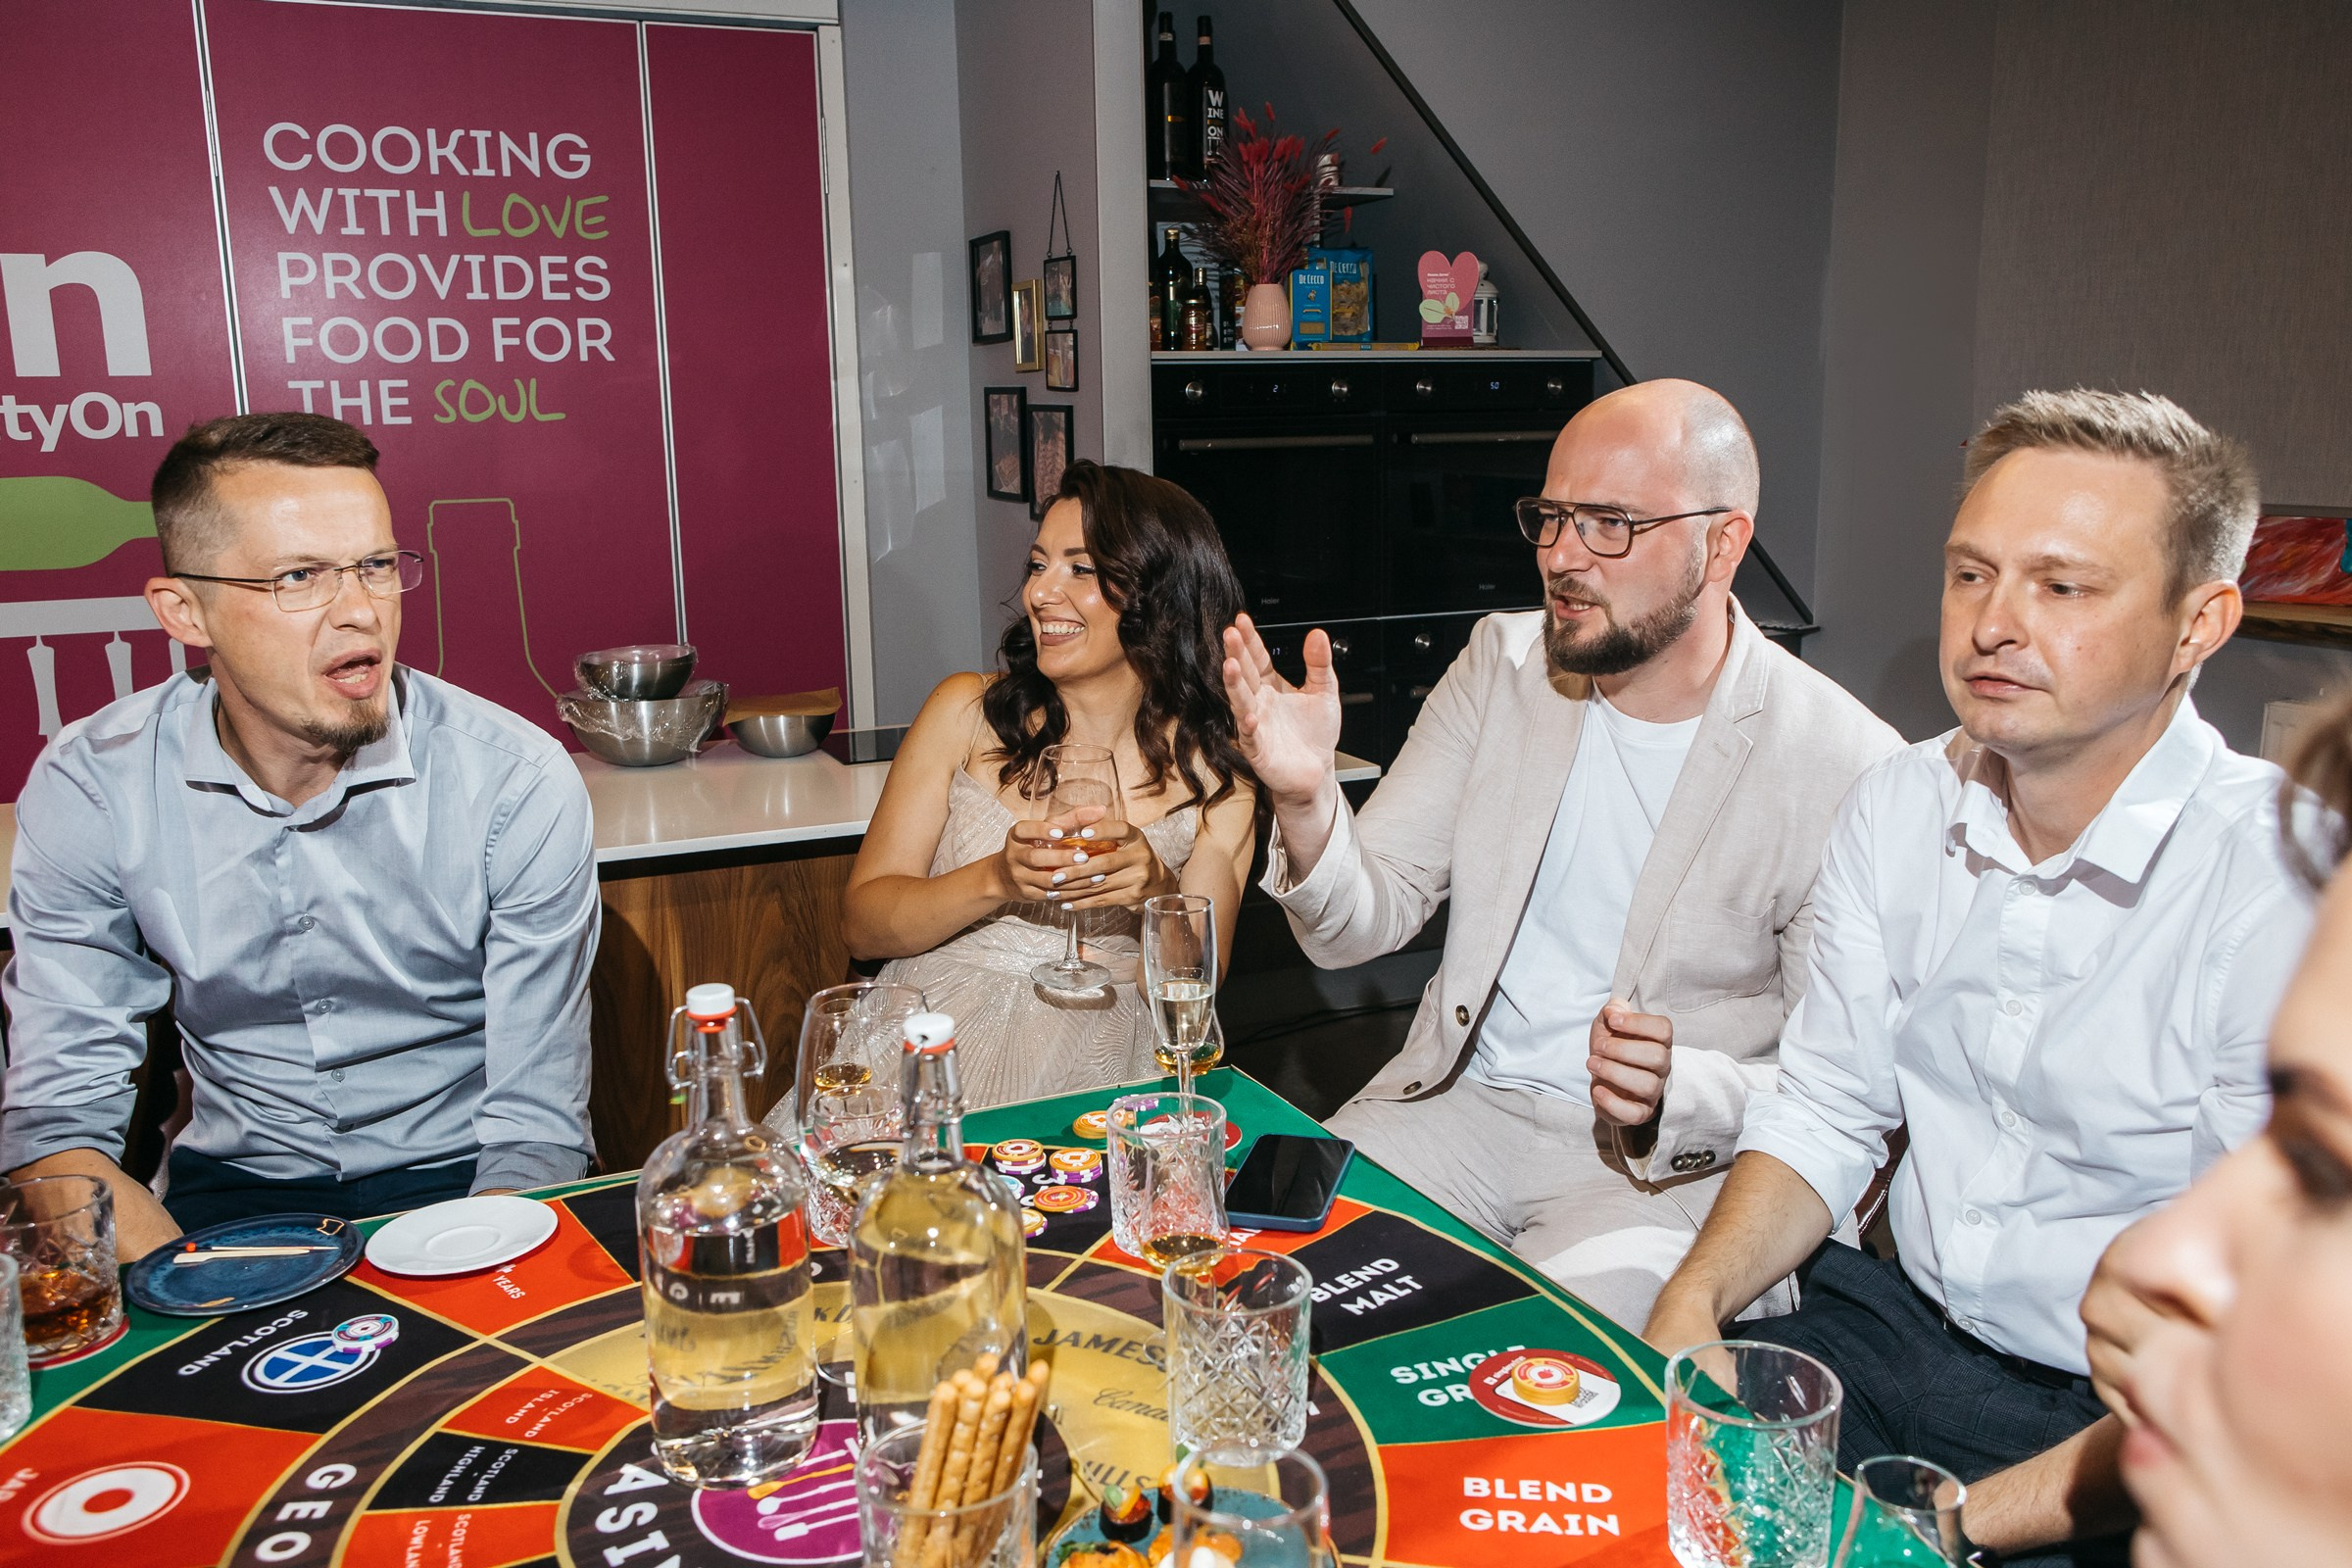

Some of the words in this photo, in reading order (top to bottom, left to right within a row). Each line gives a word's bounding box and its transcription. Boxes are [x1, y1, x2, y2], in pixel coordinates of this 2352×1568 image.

[264, 122, 591, 179] COOKING
[269, 187, 448, 237] WITH
[461, 193, 611, 240] LOVE
[278, 252, 612, 302] PROVIDES
[283, 317, 469, 364] FOOD
[493, 317, 614, 363] FOR
[0, 391, 165, 452] tyOn
[288, 379, 413, 425] THE
[433, 377, 566, 424] SOUL
[492, 1275, 526, 1299] YEARS
[1309, 1257, 1400, 1303] BLEND
[1340, 1275, 1424, 1316] MALT
[177, 1309, 309, 1376] SCOTLAND
[1032, 1328, 1166, 1373] JAMES
[1390, 1345, 1527, 1384] SING
[505, 1389, 561, 1425] ISLAND
[523, 1393, 594, 1439] SCOTLAND
[428, 1446, 486, 1503] HIGHLAND
[466, 1447, 519, 1502] SCOTLAND
[1462, 1477, 1613, 1503] BLEND
[1458, 1509, 1620, 1537] GRAIN
